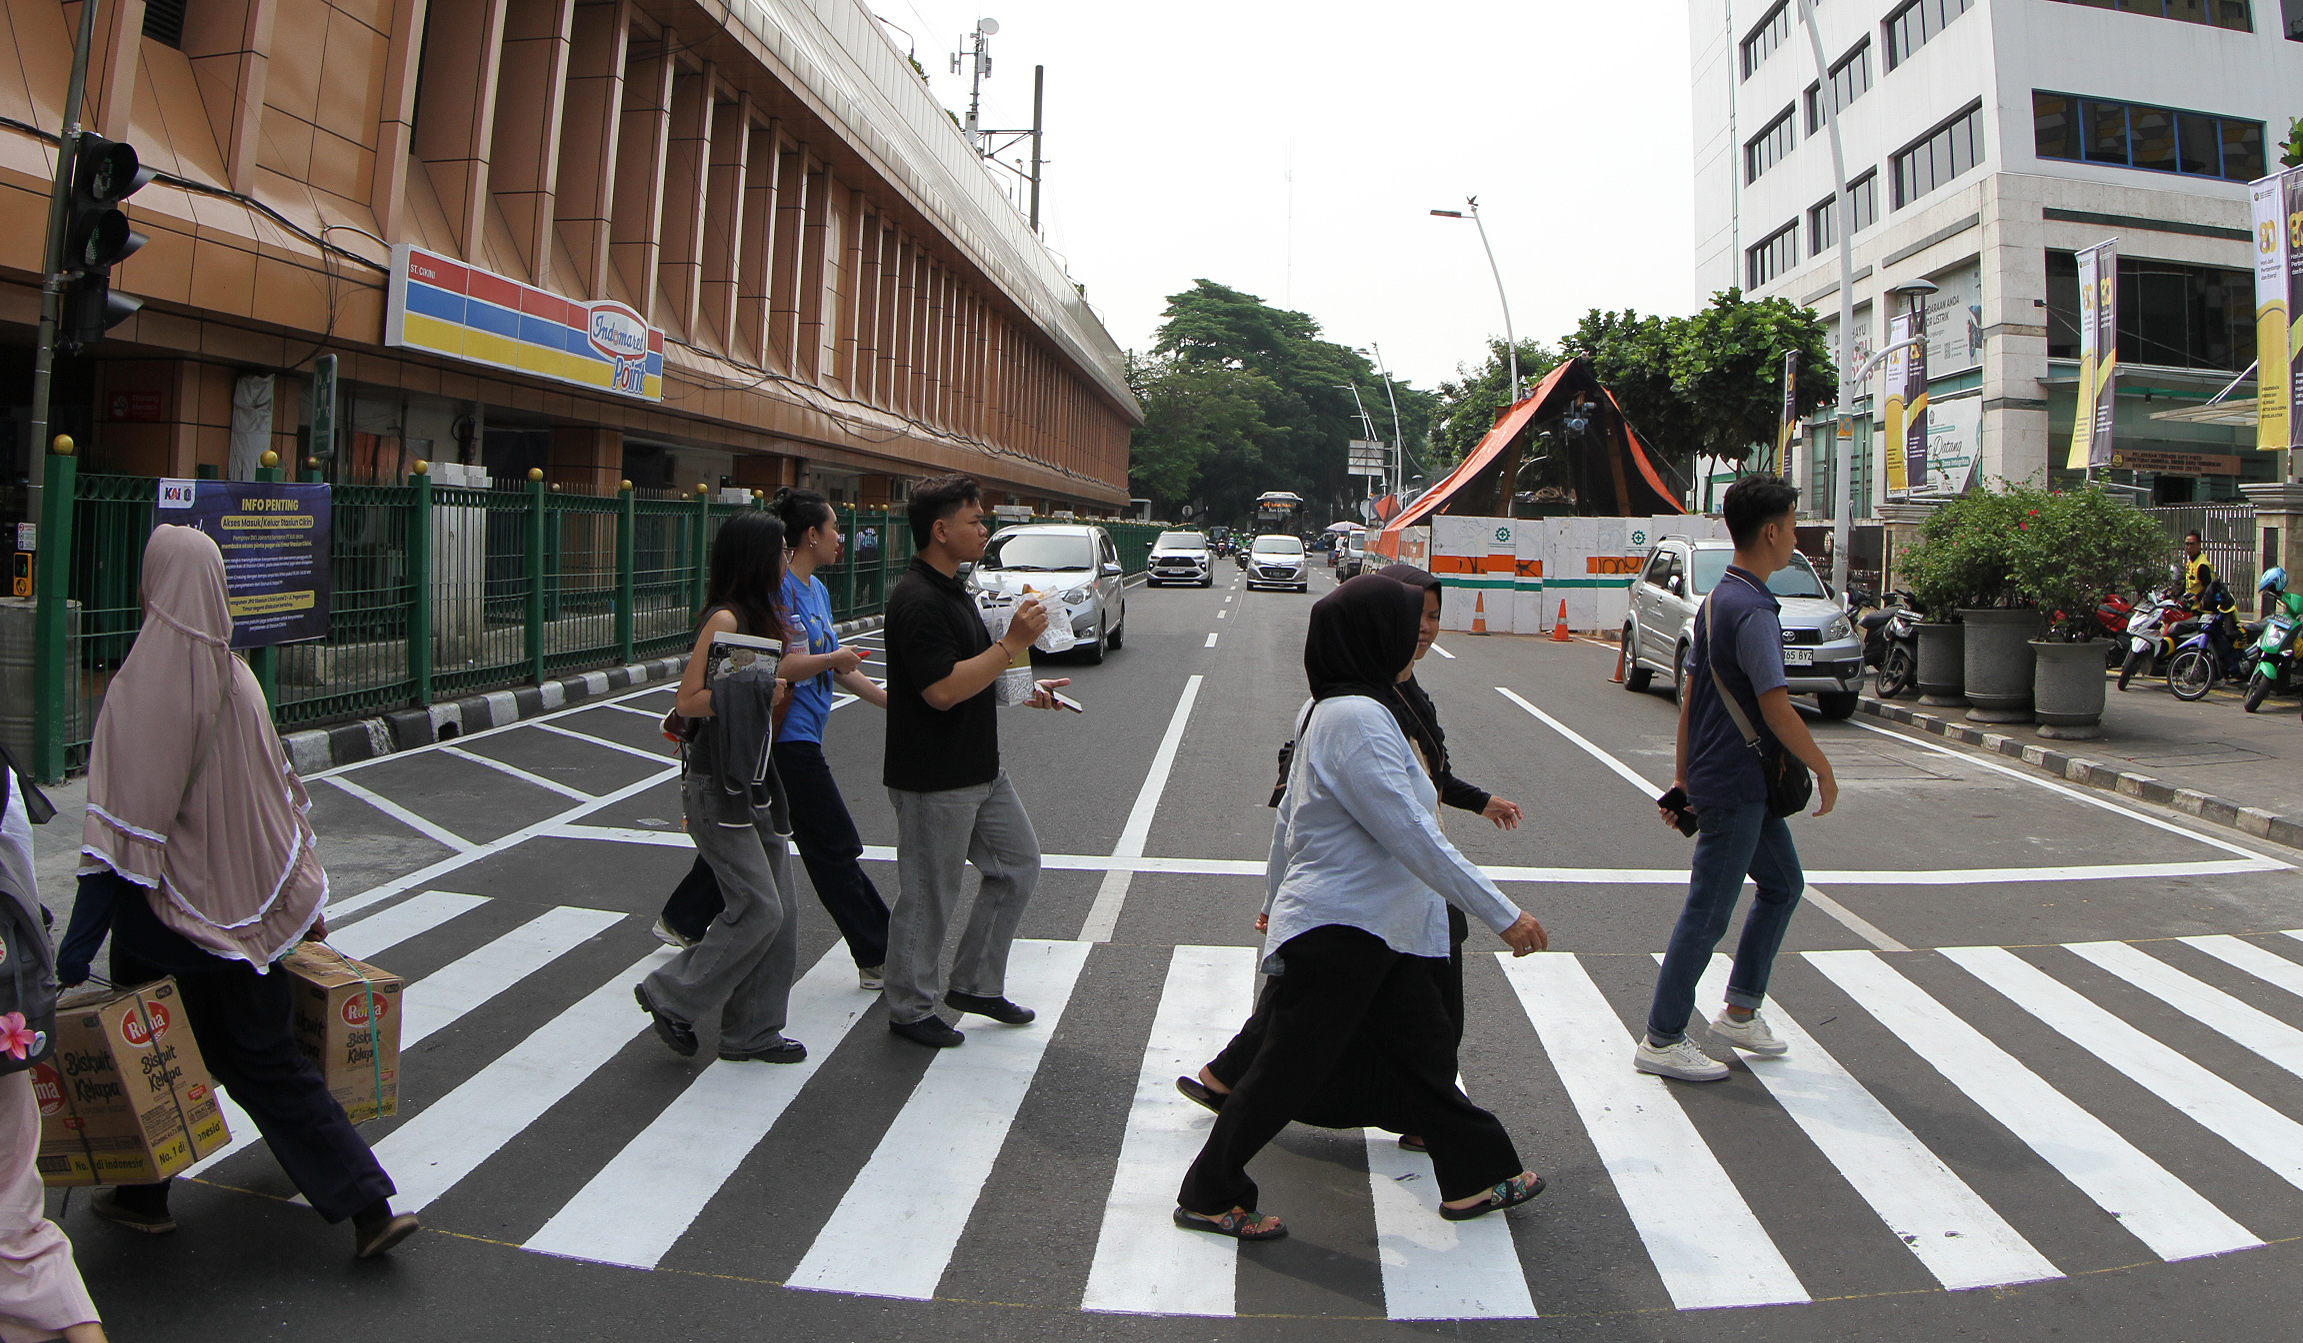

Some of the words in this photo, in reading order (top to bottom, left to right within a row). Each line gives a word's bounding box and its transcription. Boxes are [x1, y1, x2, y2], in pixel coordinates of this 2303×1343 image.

[410, 264, 418, 274] ST.
[419, 266, 436, 279] CIKINI
[592, 314, 644, 352] Indomaret
[612, 354, 647, 395] Point
[1933, 435, 1963, 458] Datang
[242, 498, 264, 512] INFO
[265, 498, 299, 512] PENTING
[222, 519, 241, 527] Akses
[280, 518, 299, 527] Stasiun
[299, 517, 313, 526] Cikini
[1799, 651, 1813, 661] BYZ
[63, 1050, 114, 1077] Biskuit
[347, 1049, 376, 1064] Kelap
[35, 1081, 61, 1100] ma
[73, 1078, 122, 1103] Kelapa
[159, 1151, 172, 1166] No.
[178, 1141, 186, 1153] di
[75, 1159, 89, 1171] No.
[96, 1159, 104, 1170] di
[105, 1158, 144, 1171] Indonesia
